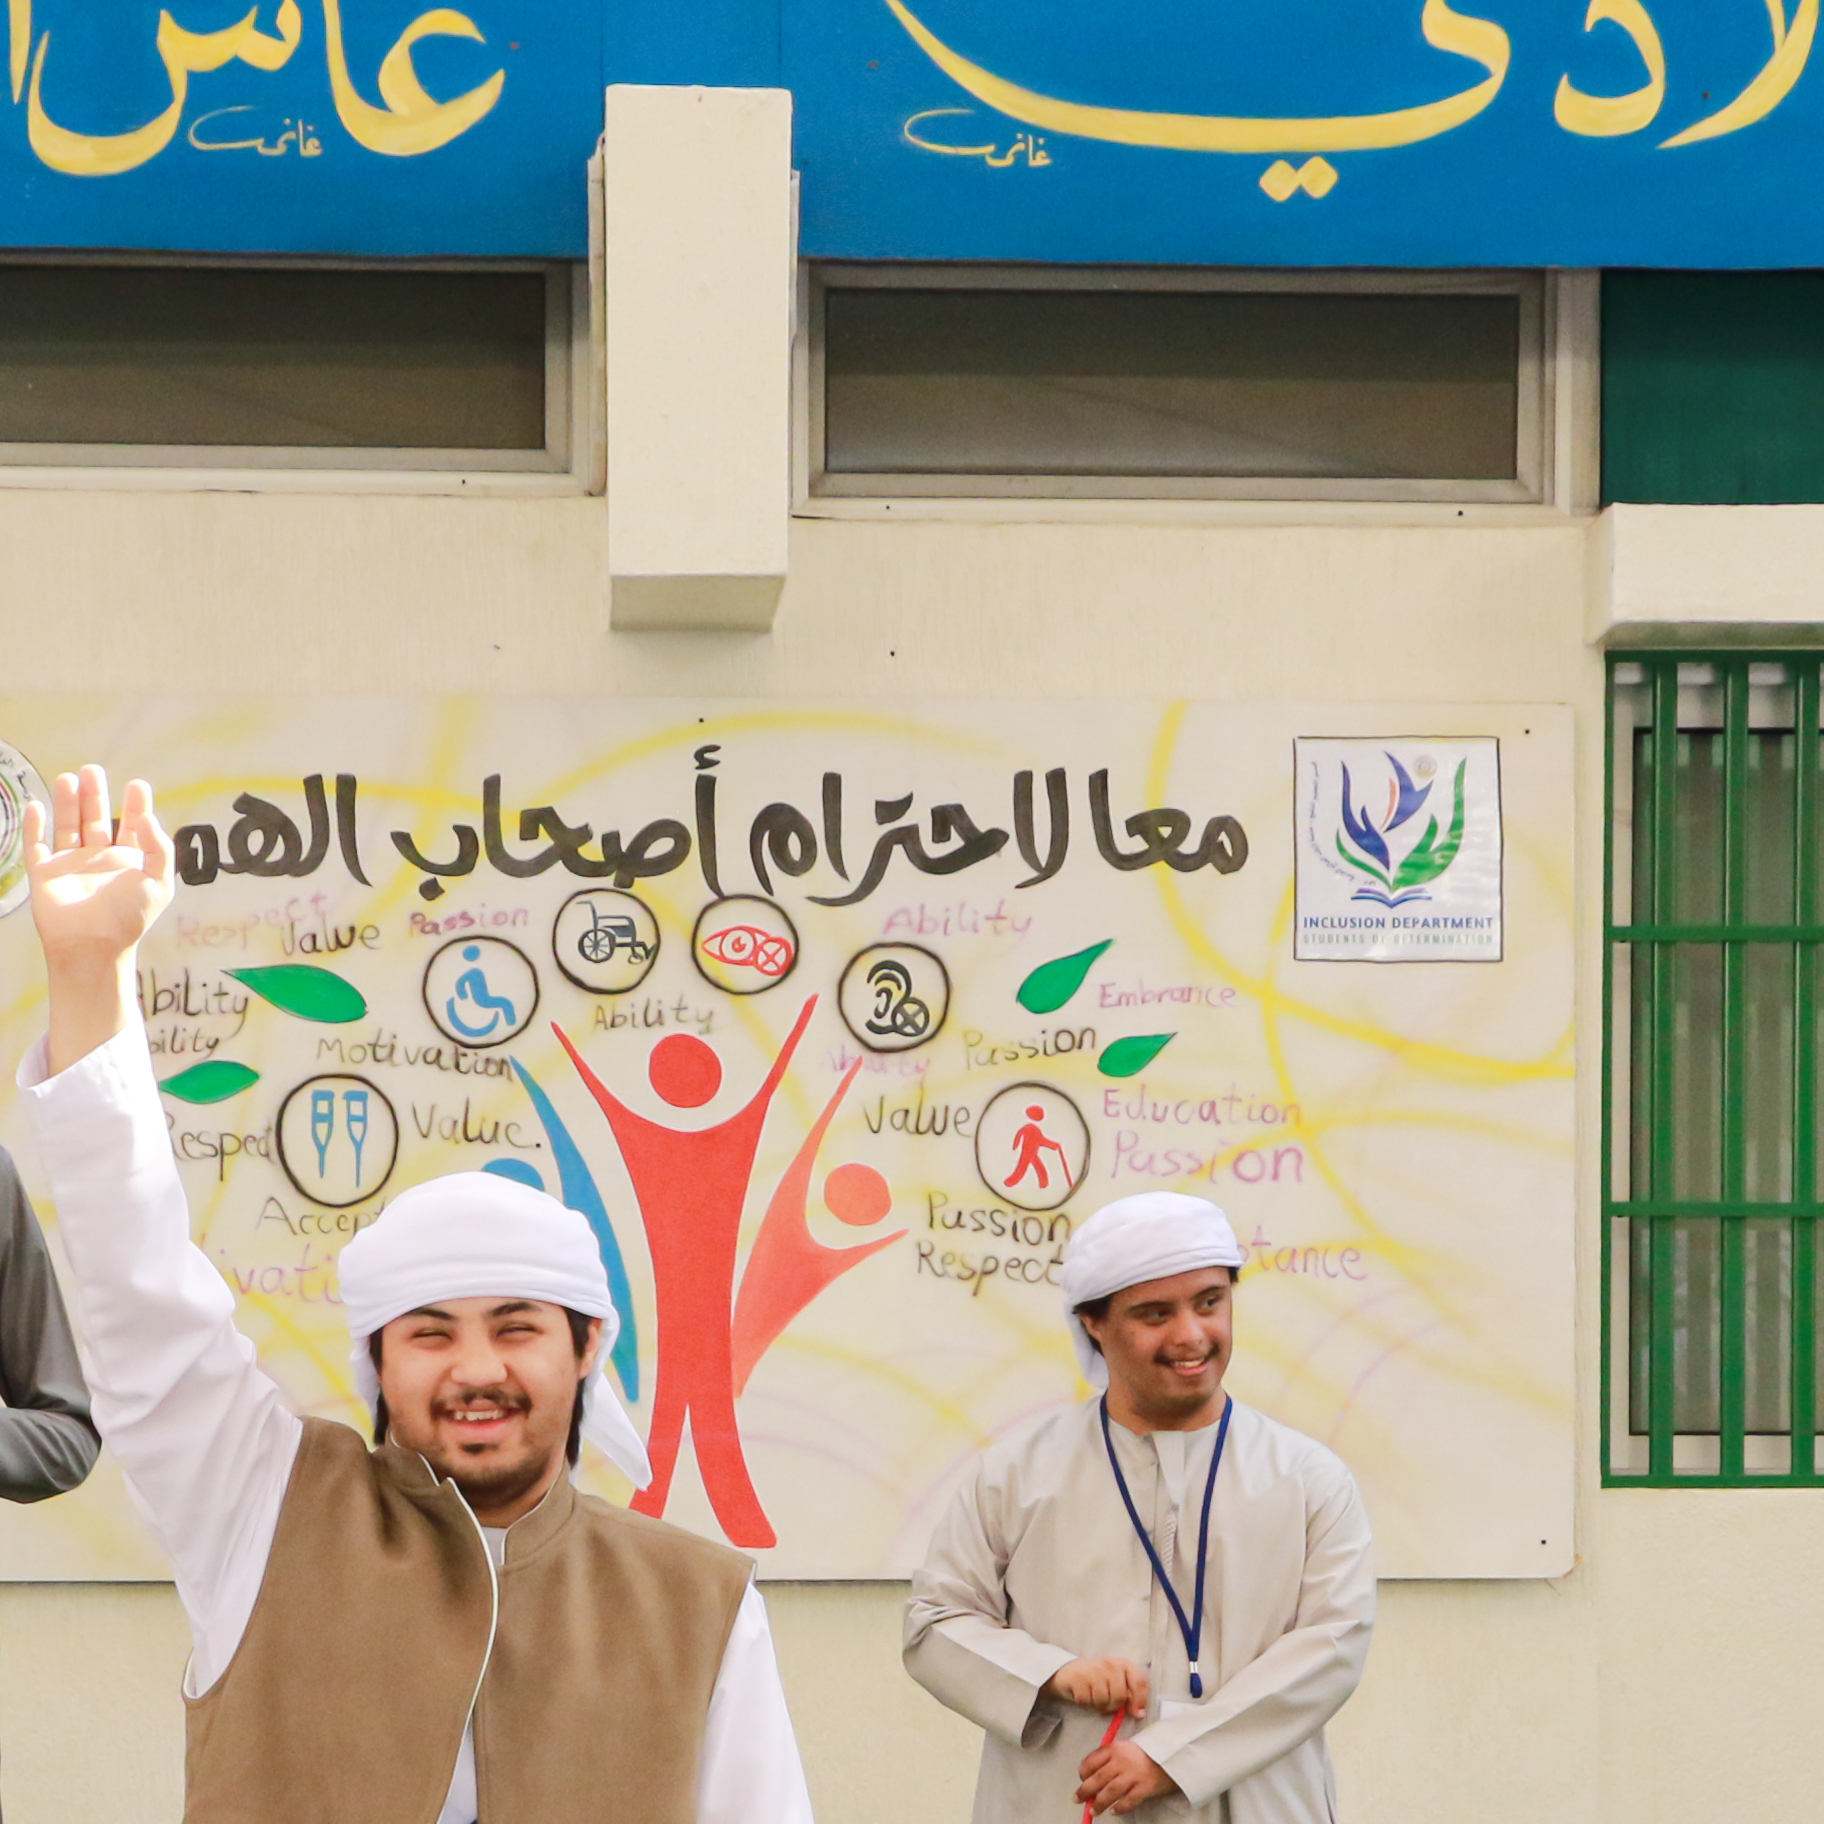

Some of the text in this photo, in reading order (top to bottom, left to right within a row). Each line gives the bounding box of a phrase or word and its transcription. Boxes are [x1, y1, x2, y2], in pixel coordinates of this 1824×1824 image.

[113, 773, 373, 886] الهم
[280, 914, 381, 957] Value
[409, 906, 530, 937] Passion
[881, 898, 1034, 945] Ability
[1303, 916, 1494, 930] INCLUSION DEPARTMENT
[593, 993, 716, 1036] Ability
[317, 1027, 515, 1084] Motivation
[964, 1026, 1097, 1072] Passion
[862, 1084, 972, 1138] Value
[1103, 1084, 1304, 1127] Education
[1110, 1129, 1305, 1185] Passion
[926, 1192, 1072, 1246] Passion
